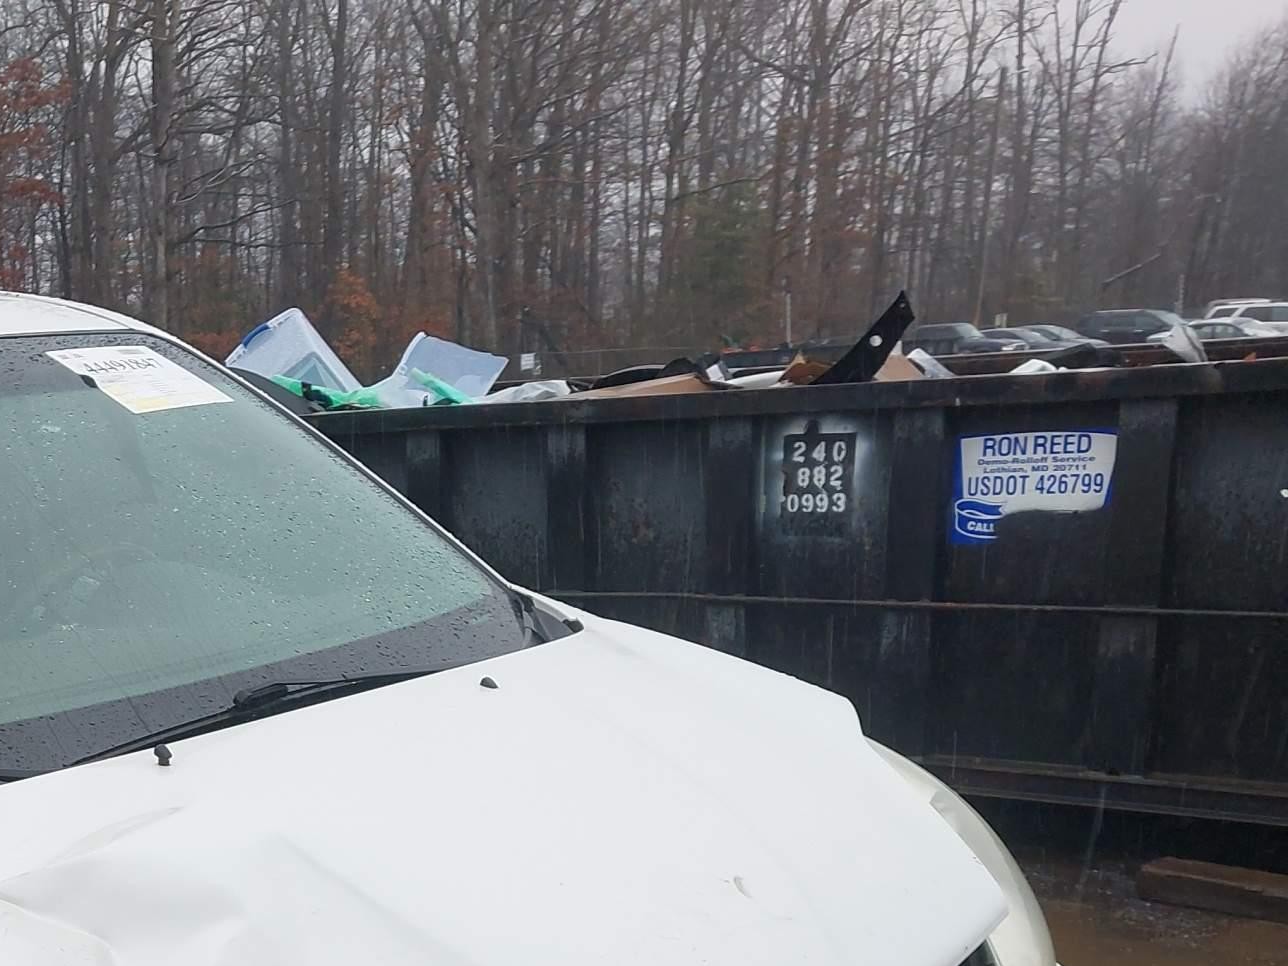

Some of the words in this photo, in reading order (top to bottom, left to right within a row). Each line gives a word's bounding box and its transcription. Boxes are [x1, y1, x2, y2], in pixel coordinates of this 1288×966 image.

[792, 441, 847, 463] 240
[982, 436, 1028, 457] RON
[1032, 433, 1092, 455] REED
[1051, 455, 1096, 463] Service
[1053, 463, 1087, 472] 20711
[797, 465, 843, 488] 882
[967, 475, 1030, 497] USDOT
[1034, 472, 1104, 495] 426799
[787, 493, 847, 513] 0993
